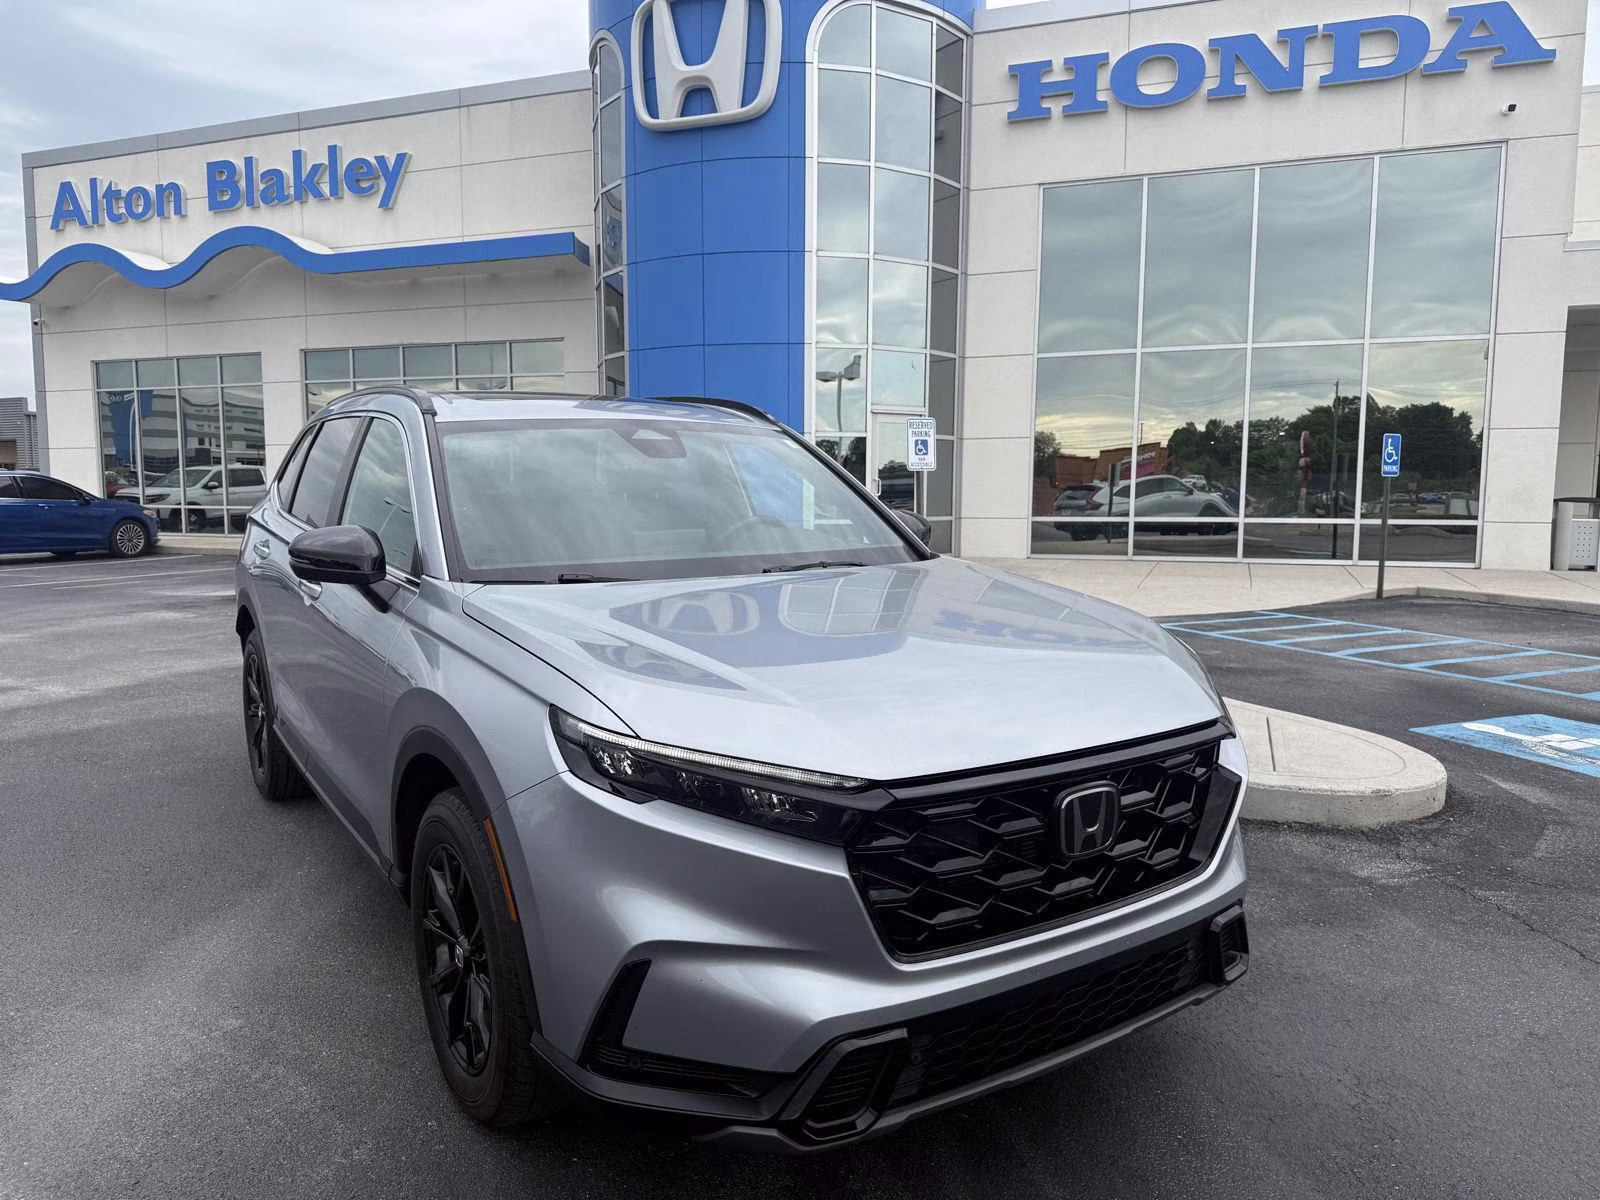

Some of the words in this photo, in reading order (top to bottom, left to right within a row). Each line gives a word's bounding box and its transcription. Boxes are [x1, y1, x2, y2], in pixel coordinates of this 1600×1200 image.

[1007, 0, 1556, 122] HONDA
[50, 177, 186, 231] Alton
[205, 144, 411, 212] Blakley
[909, 421, 933, 430] RESERVED
[911, 430, 931, 438] PARKING
